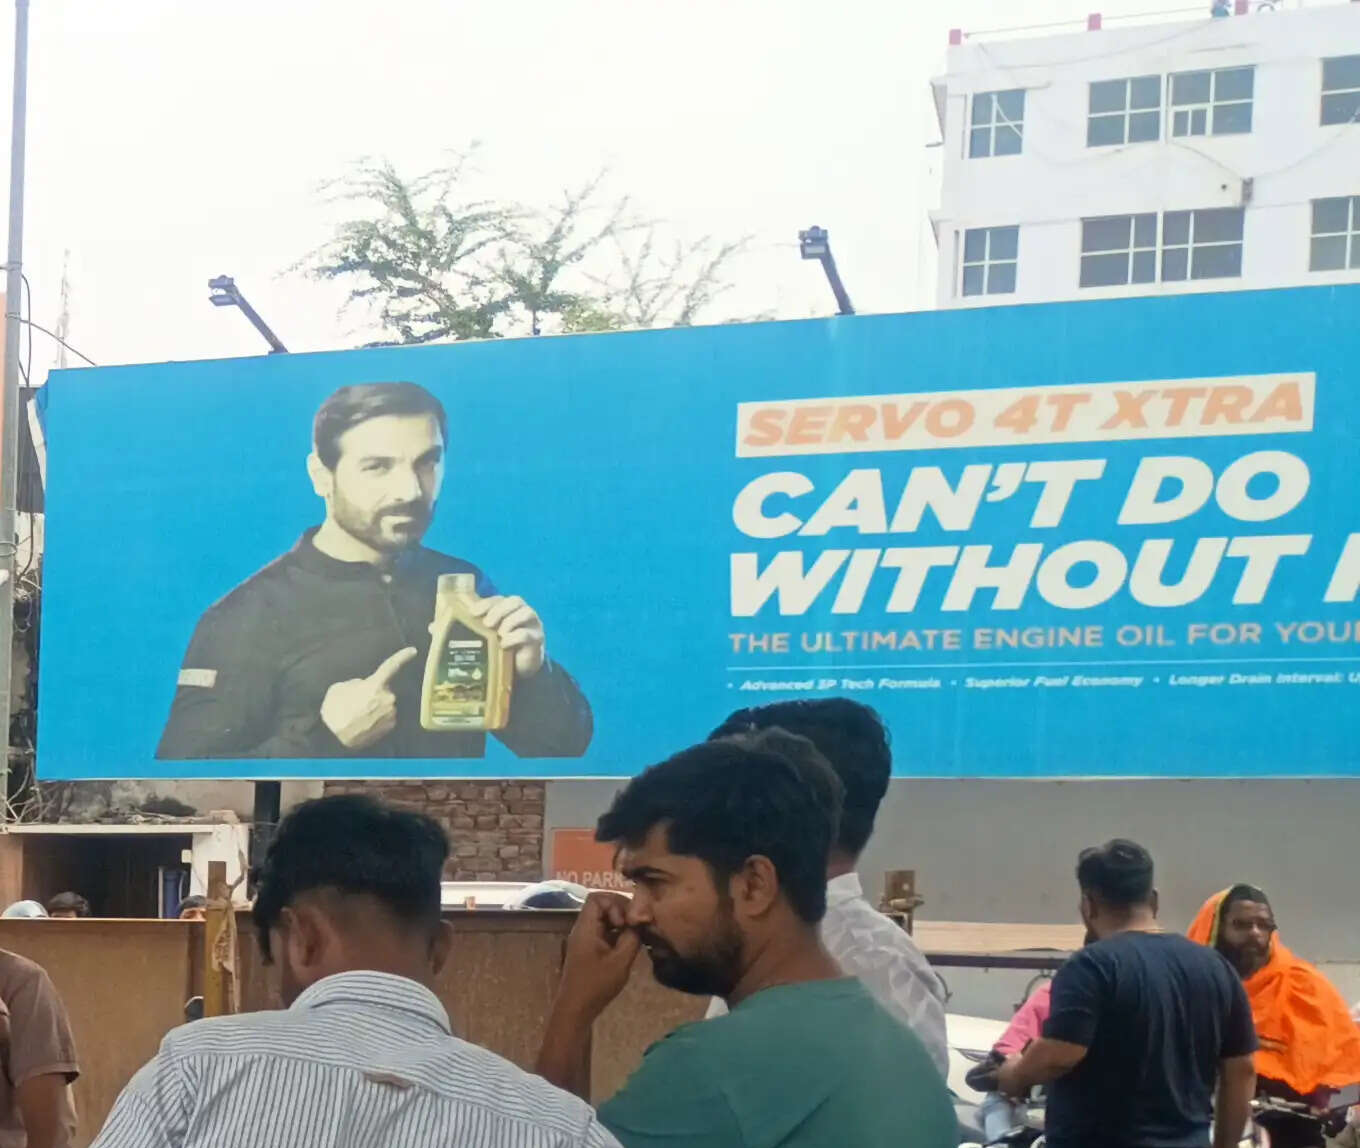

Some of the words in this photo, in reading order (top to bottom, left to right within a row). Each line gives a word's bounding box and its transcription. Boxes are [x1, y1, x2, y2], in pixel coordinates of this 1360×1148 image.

[743, 399, 976, 447] SERVO
[993, 392, 1092, 434] 4T
[1098, 381, 1303, 430] XTRA
[1116, 449, 1311, 523] DO
[730, 533, 1314, 617] WITHOUT
[729, 632, 790, 654] THE
[801, 628, 962, 652] ULTIMATE
[973, 624, 1103, 650] ENGINE
[1116, 623, 1175, 648] OIL
[1187, 621, 1262, 645] FOR
[1275, 620, 1360, 644] YOU
